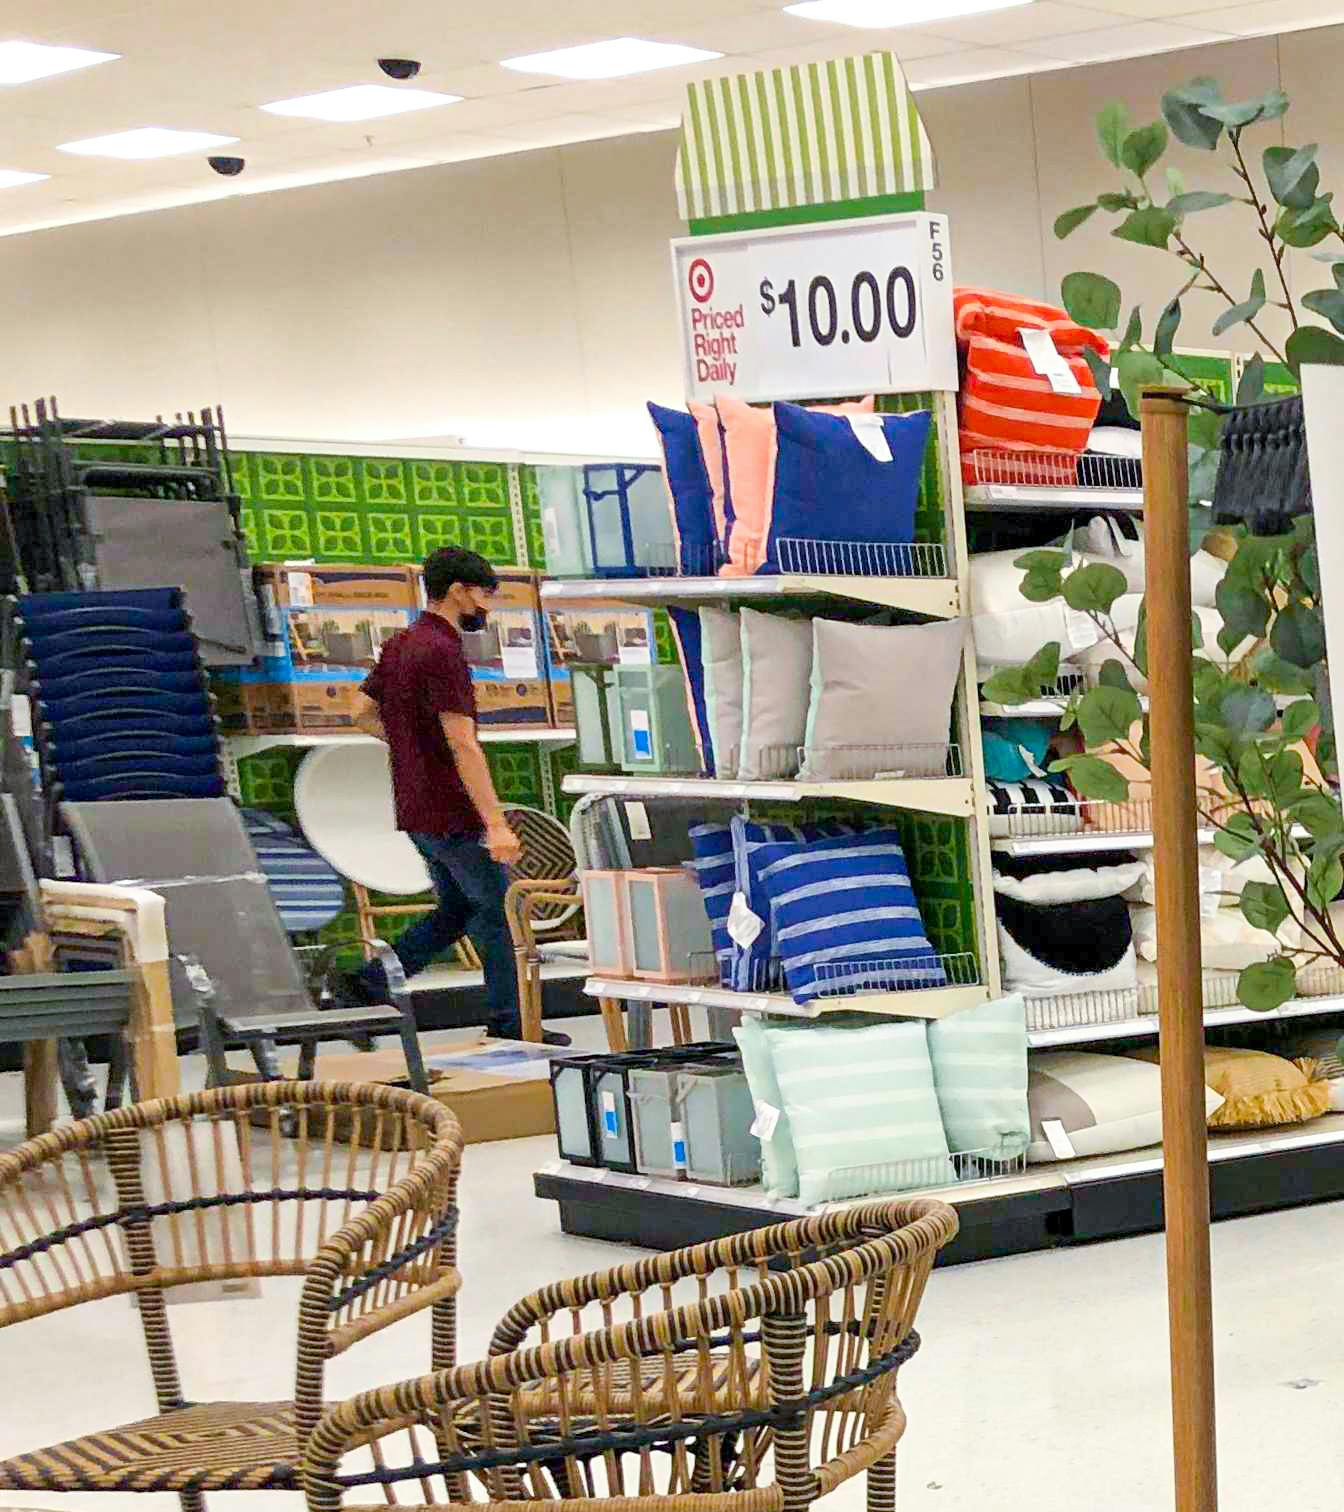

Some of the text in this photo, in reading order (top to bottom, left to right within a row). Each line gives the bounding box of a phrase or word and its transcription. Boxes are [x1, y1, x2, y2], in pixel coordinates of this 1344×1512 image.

[691, 304, 745, 331] Priced
[760, 265, 917, 348] $10.00
[694, 333, 738, 361] Right
[697, 359, 736, 386] Daily
